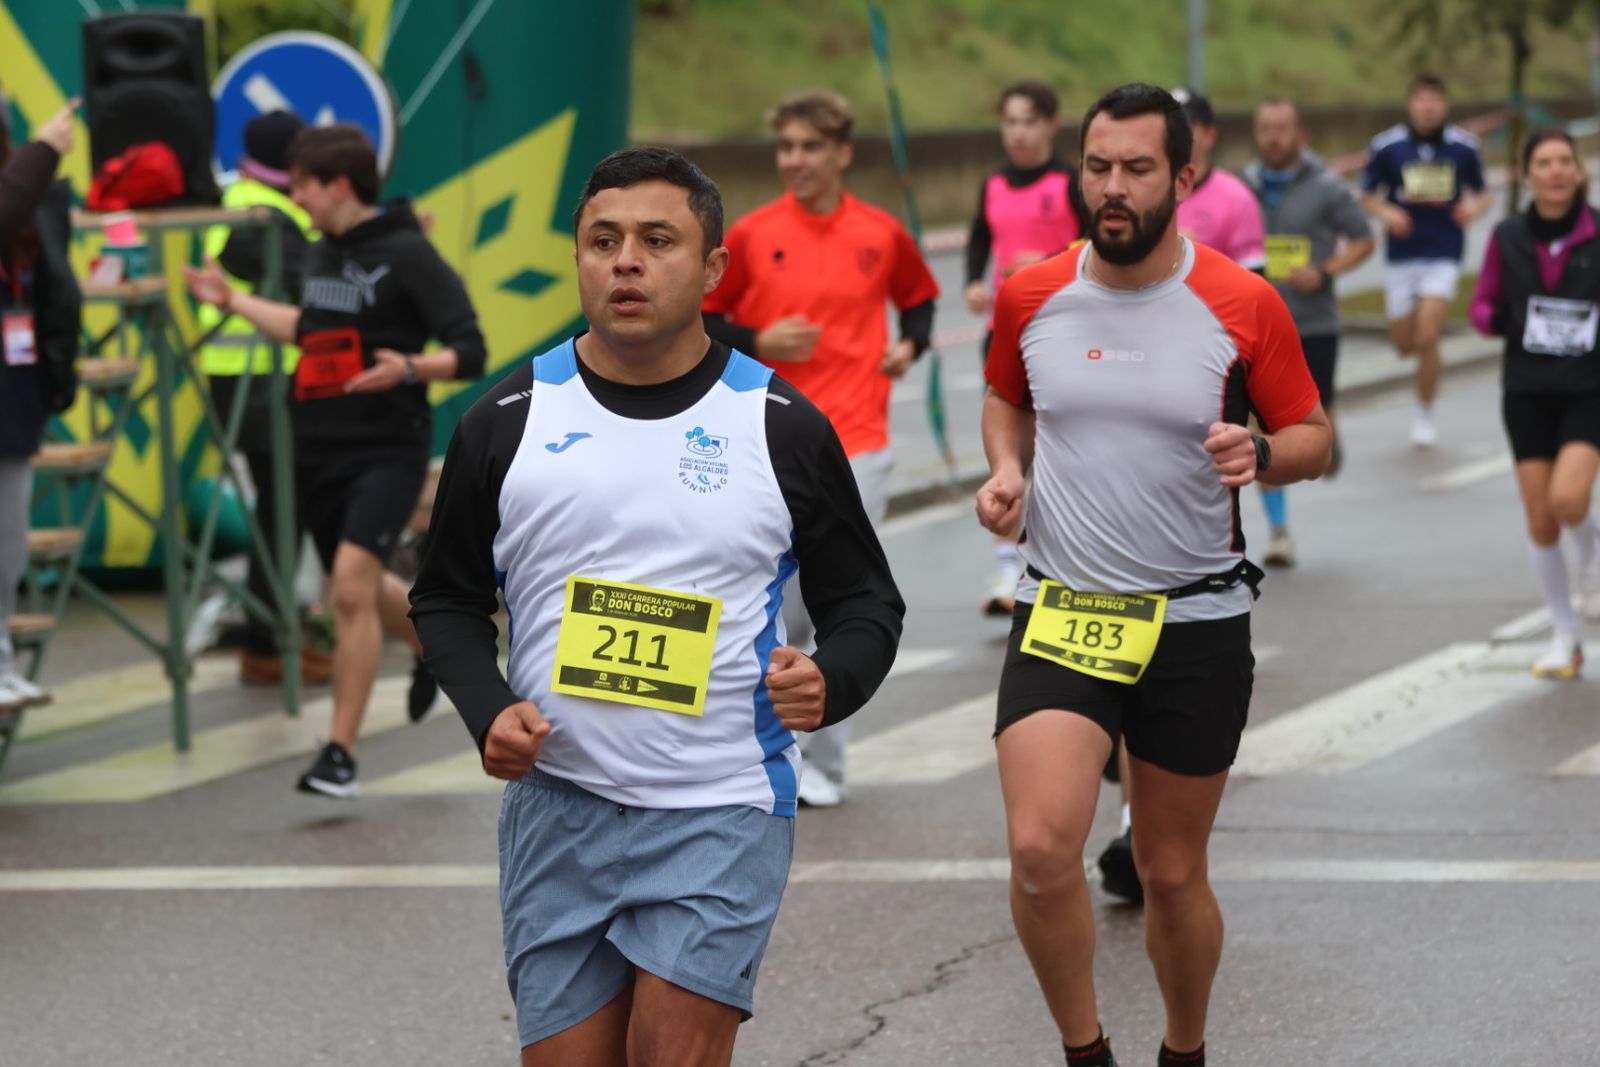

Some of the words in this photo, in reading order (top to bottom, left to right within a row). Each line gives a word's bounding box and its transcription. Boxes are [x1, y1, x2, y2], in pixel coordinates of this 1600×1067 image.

[680, 462, 692, 470] LOS
[694, 464, 728, 475] ALCALDES
[679, 471, 728, 494] RUNNING
[608, 598, 632, 611] DON
[634, 603, 673, 618] BOSCO
[610, 590, 627, 600] XXXI
[627, 593, 661, 605] CARRERA
[662, 598, 696, 611] POPULAR
[1074, 596, 1094, 607] DON
[1094, 599, 1126, 611] BOSCO
[1060, 618, 1125, 651] 183
[592, 624, 669, 671] 211
